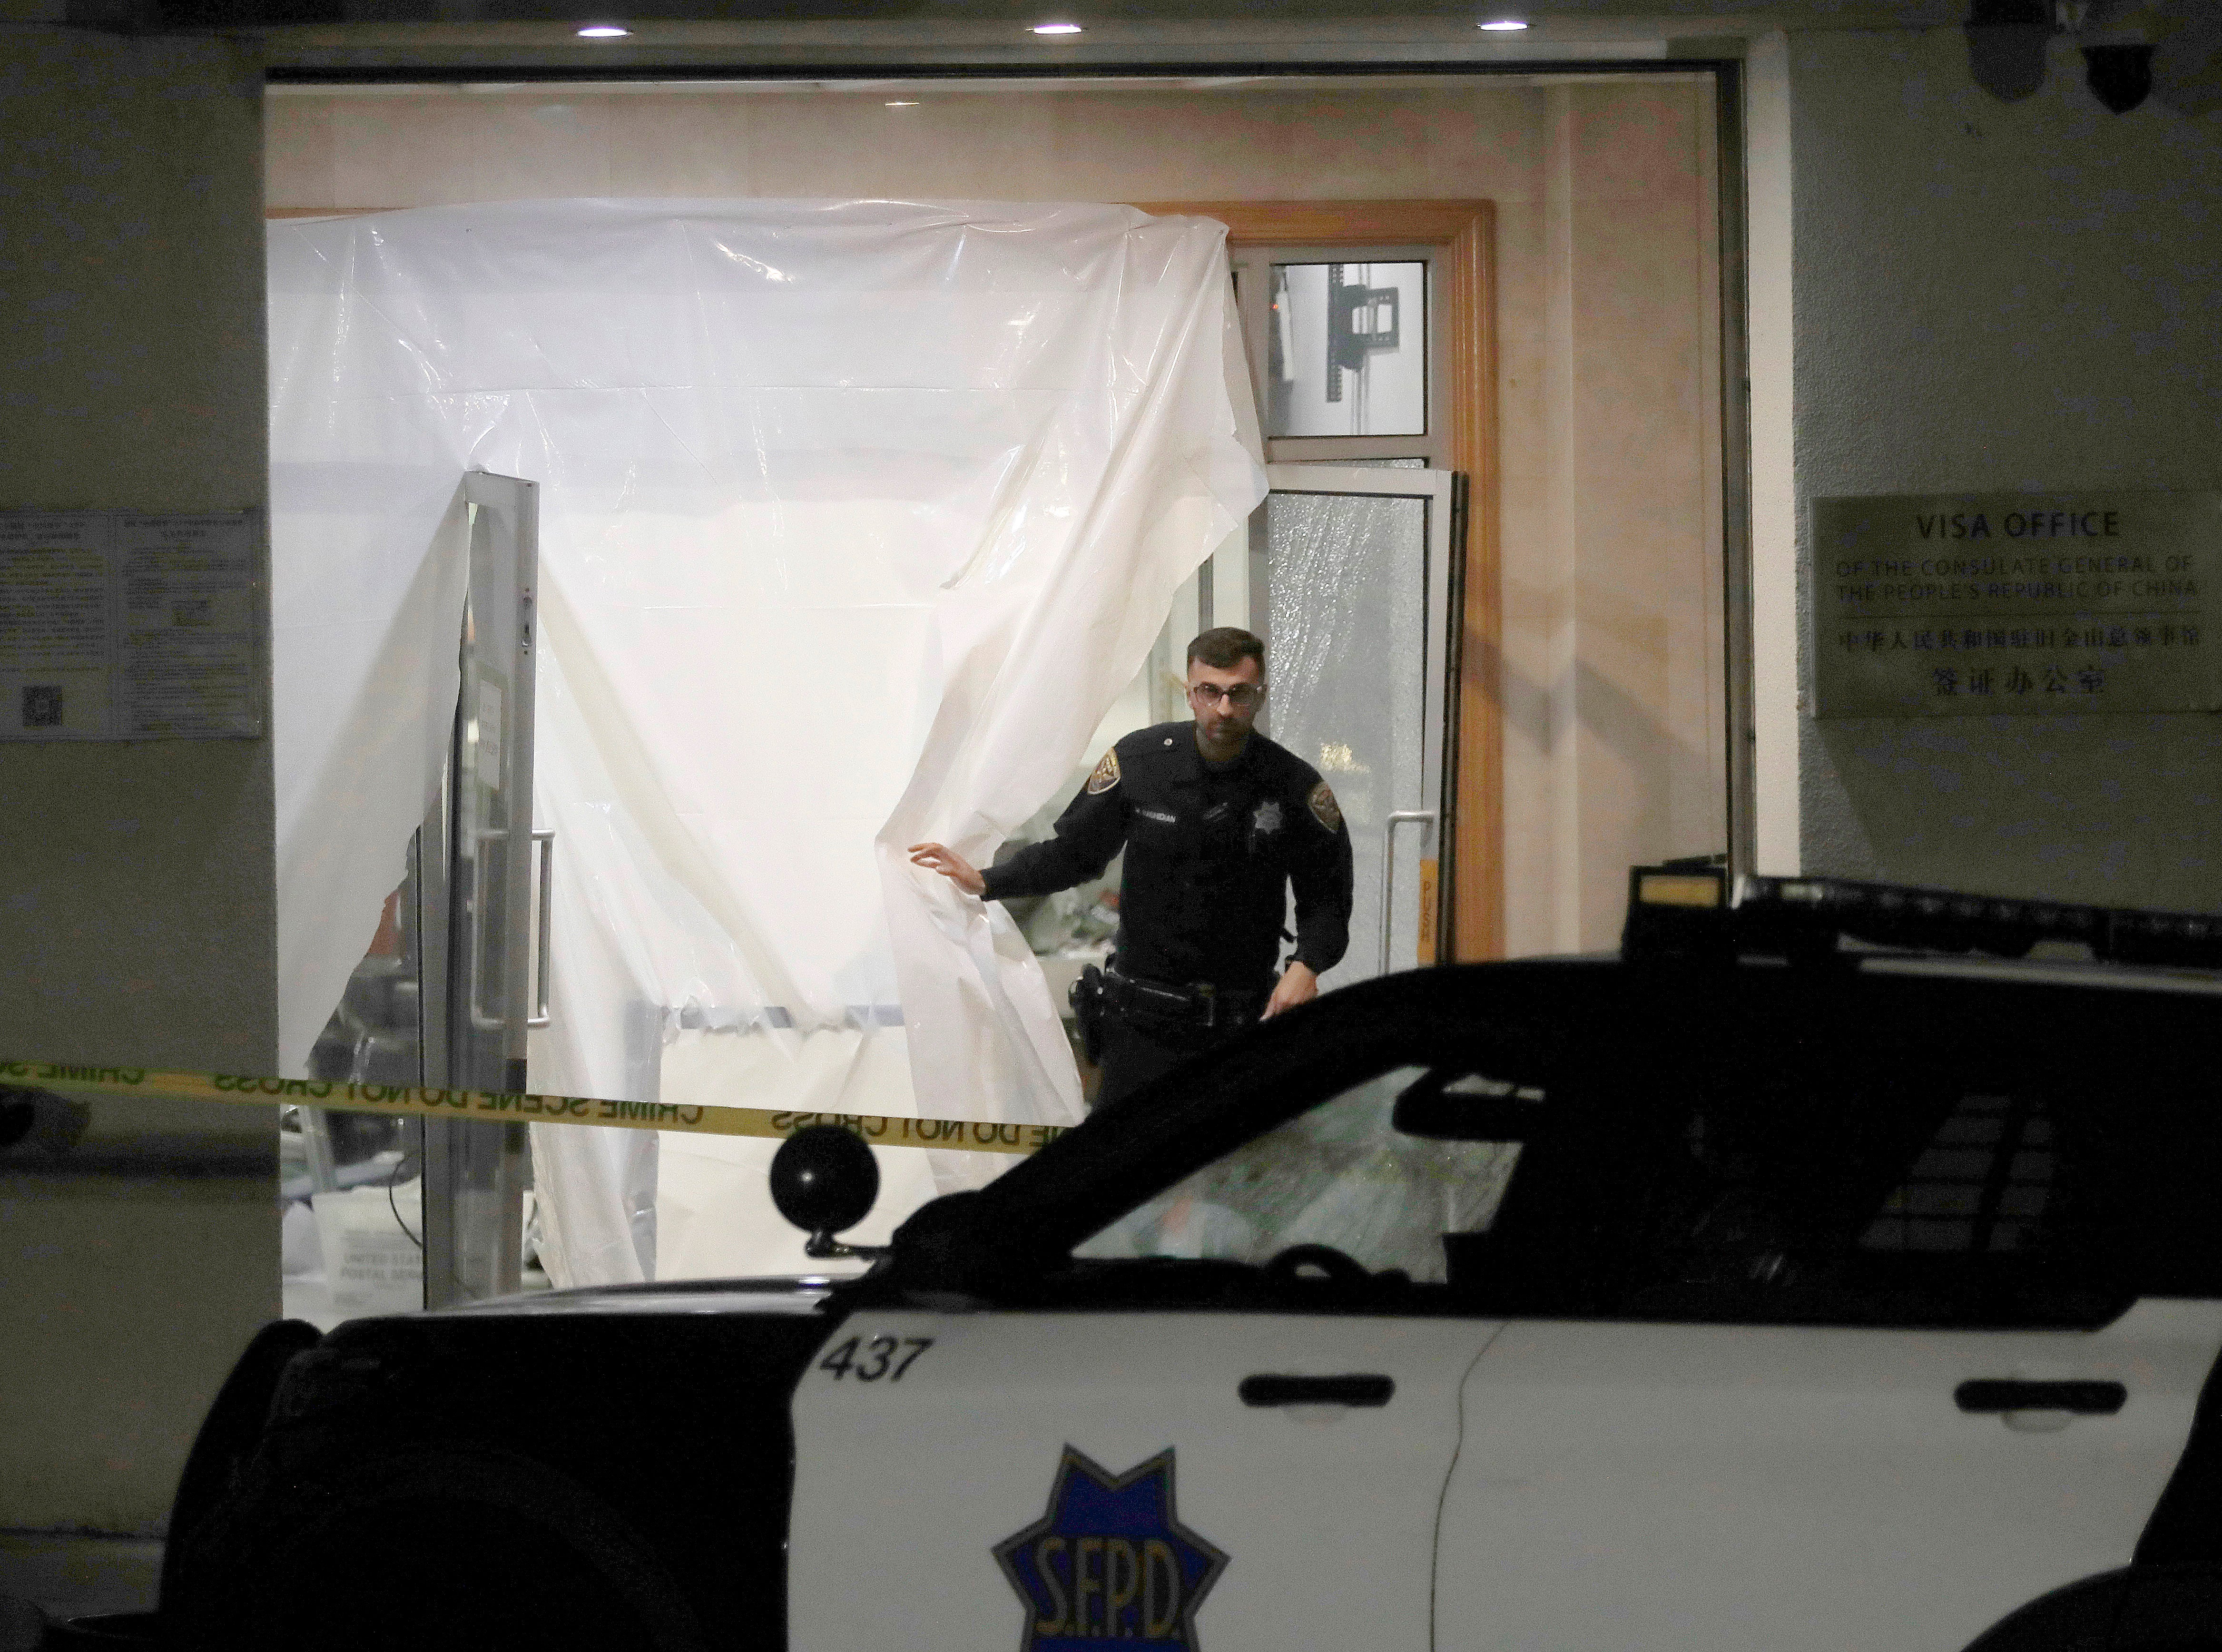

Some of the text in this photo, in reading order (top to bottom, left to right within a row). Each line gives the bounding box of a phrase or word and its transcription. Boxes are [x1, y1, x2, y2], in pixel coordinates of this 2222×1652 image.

[1917, 511, 2120, 539] VISA OFFICE
[1836, 555, 2193, 577] OF THE CONSULATE GENERAL OF
[1836, 579, 2198, 601] THE PEOPLE'S REPUBLIC OF CHINA
[1838, 624, 2201, 652] 中华人民共和国驻旧金山总领事馆
[1932, 664, 2106, 696] 签证办公室
[1421, 880, 1432, 943] PUSH
[819, 1335, 936, 1383] 437
